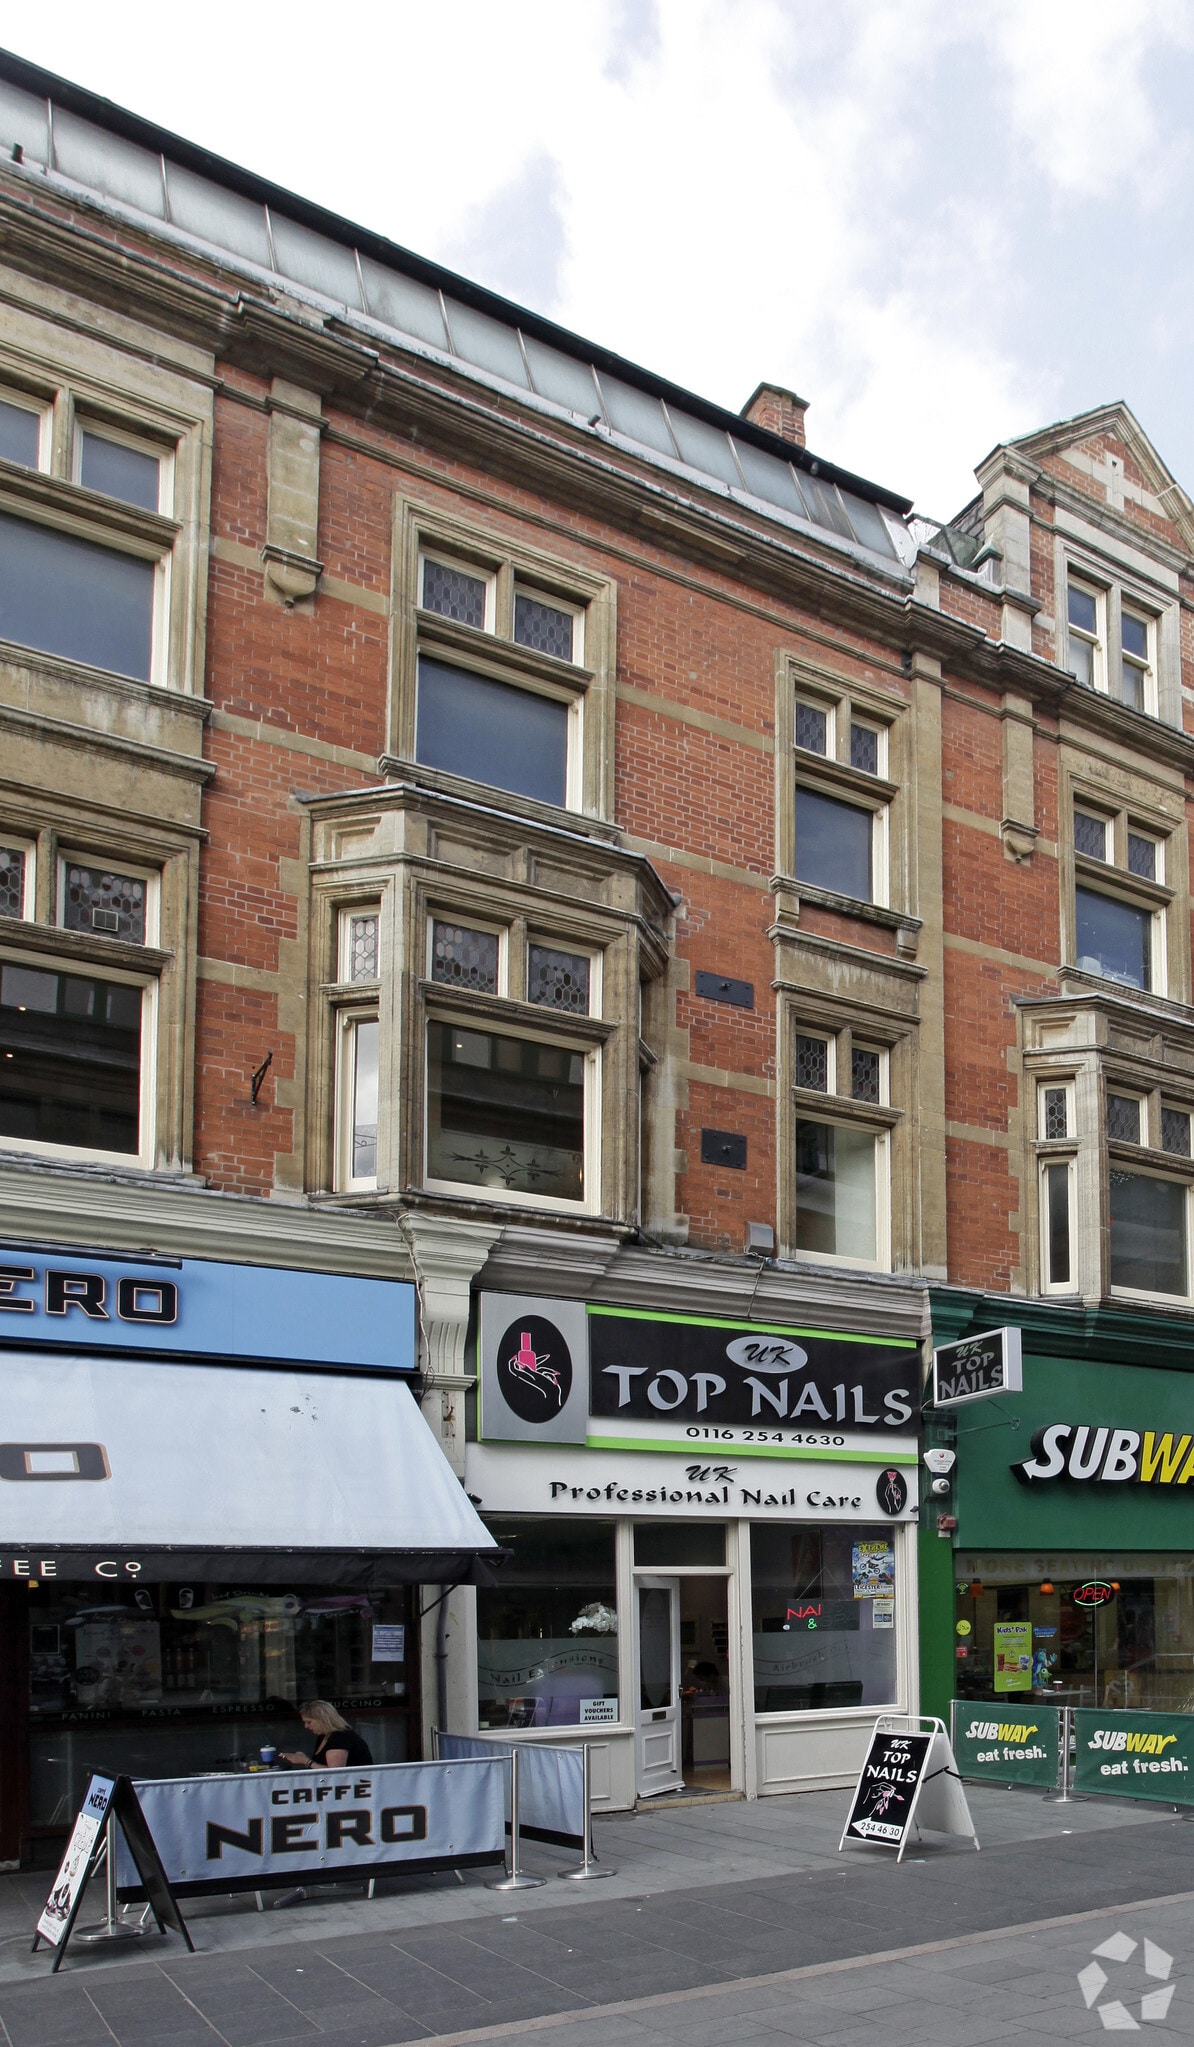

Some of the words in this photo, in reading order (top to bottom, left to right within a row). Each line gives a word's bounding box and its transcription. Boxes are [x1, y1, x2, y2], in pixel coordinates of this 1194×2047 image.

[743, 1343, 793, 1366] UK
[956, 1341, 983, 1358] UK
[952, 1352, 995, 1374] TOP
[939, 1365, 1003, 1400] NAILS
[602, 1364, 726, 1412] TOP
[743, 1376, 913, 1426] NAILS
[686, 1427, 734, 1440] 0116
[742, 1430, 783, 1443] 254
[791, 1433, 845, 1446] 4630
[685, 1465, 738, 1483] UK
[549, 1481, 729, 1504] Professional
[739, 1488, 796, 1507] Nail
[806, 1491, 863, 1508] Care
[1073, 1587, 1112, 1600] OPEN
[807, 1618, 817, 1629] &
[490, 1673, 520, 1683] Nail
[62, 1711, 111, 1721] PANINI
[142, 1708, 182, 1716] PASTA
[212, 1703, 276, 1713] ESPRESSO
[965, 1721, 1039, 1744] SUBWAY
[890, 1739, 912, 1750] UK
[1087, 1730, 1178, 1755] SUBWAY
[883, 1751, 911, 1765] TOP
[976, 1748, 1000, 1763] eat
[867, 1765, 918, 1783] NAILS
[1100, 1760, 1129, 1776] eat
[271, 1779, 372, 1805] CAFFÈ
[206, 1805, 428, 1860] NERO
[860, 1822, 875, 1832] 254
[877, 1824, 887, 1834] 46
[889, 1827, 900, 1837] 30
